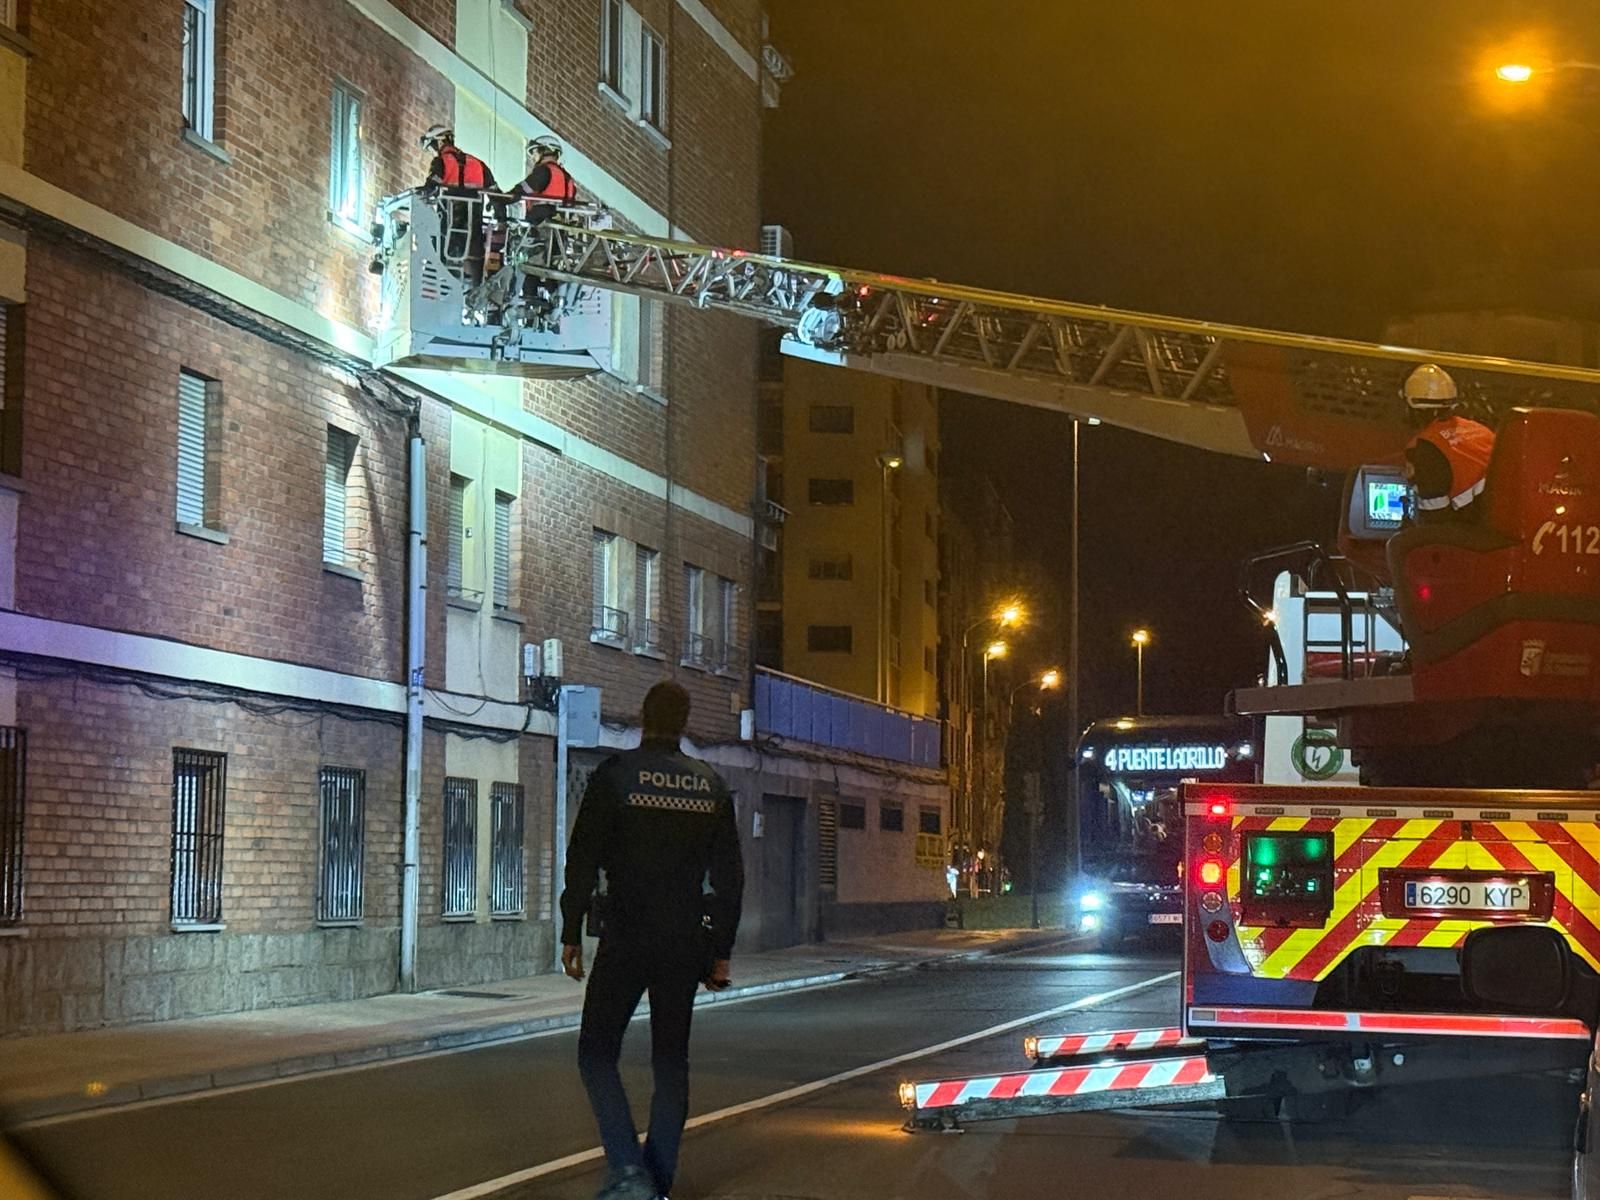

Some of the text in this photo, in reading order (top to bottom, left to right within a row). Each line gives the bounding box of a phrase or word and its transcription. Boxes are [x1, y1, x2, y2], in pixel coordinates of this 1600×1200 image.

[1556, 524, 1600, 554] 112
[1105, 748, 1117, 771] 4
[639, 771, 711, 792] POLICÍA
[1420, 886, 1523, 907] 6290 KYP
